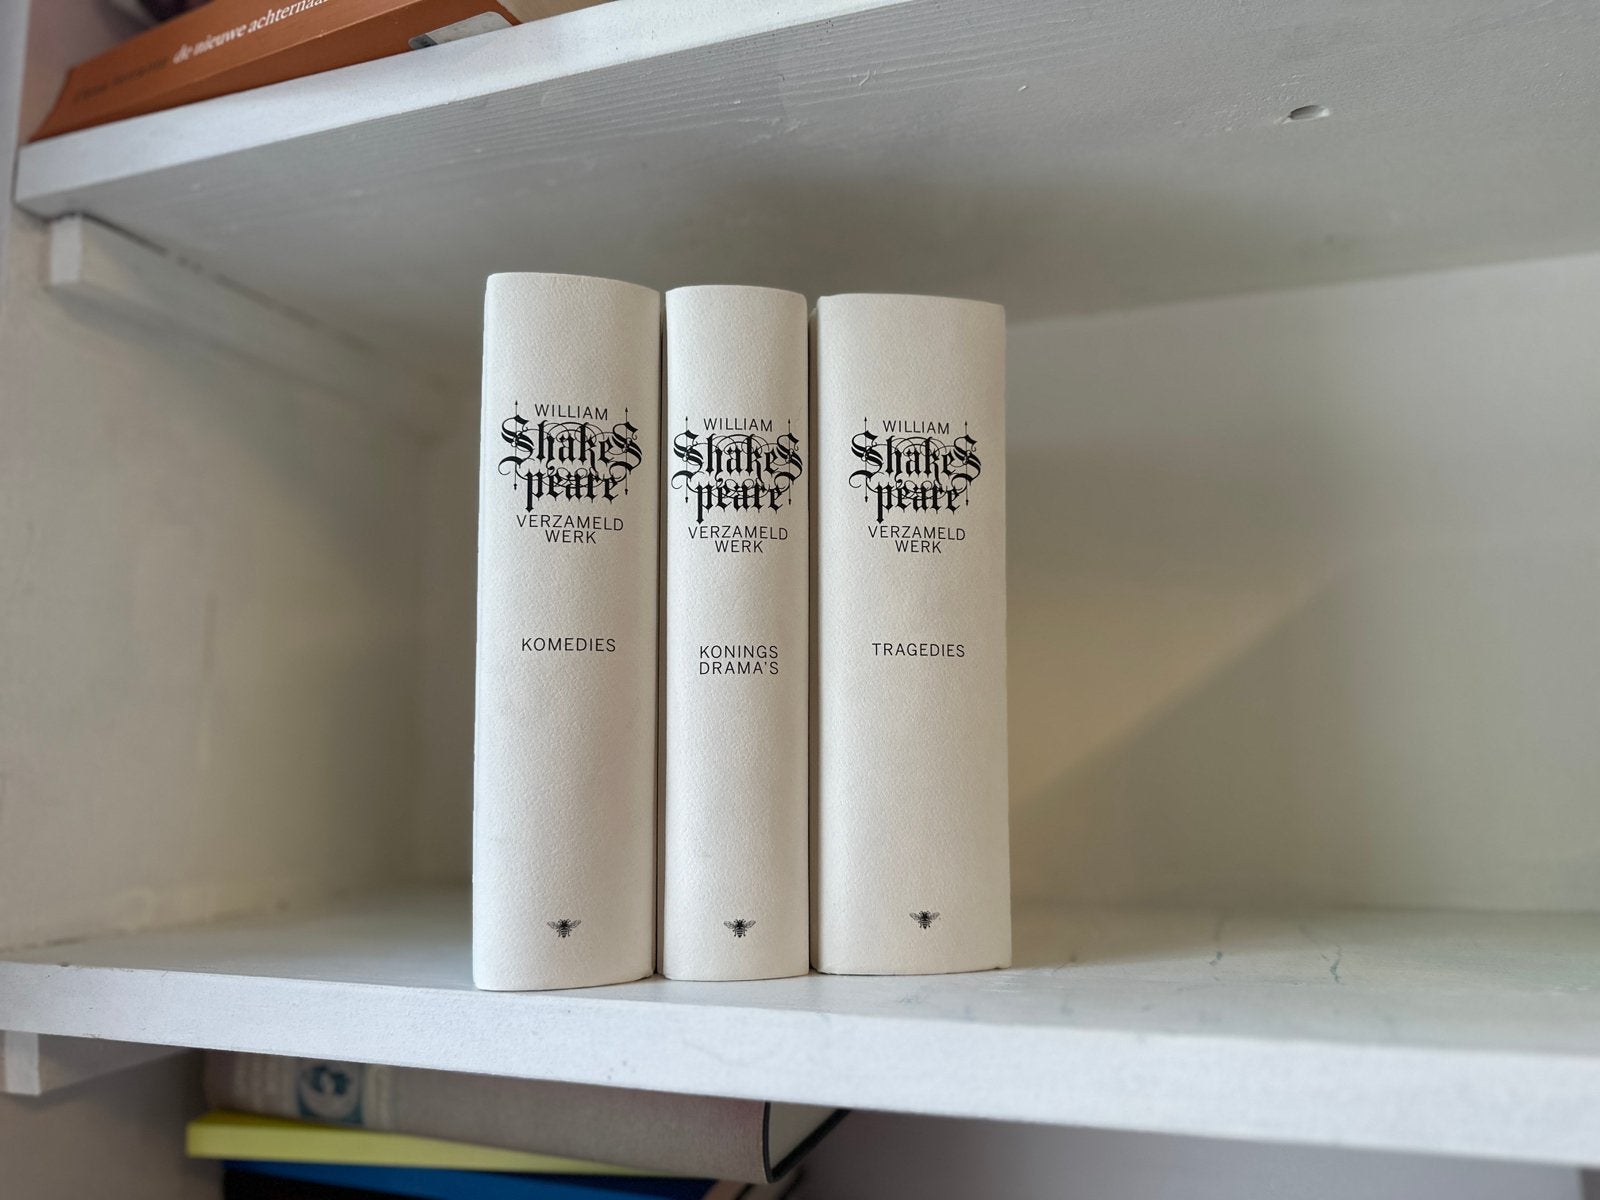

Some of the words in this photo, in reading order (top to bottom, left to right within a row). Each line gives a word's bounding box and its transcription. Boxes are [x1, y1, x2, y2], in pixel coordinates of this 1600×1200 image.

[172, 43, 194, 64] de
[193, 24, 247, 56] nieuwe
[534, 403, 608, 421] WILLIAM
[703, 417, 773, 432] WILLIAM
[882, 419, 950, 435] WILLIAM
[524, 468, 619, 513] peare
[695, 481, 783, 524] peare
[874, 482, 960, 524] peare
[516, 514, 624, 531] VERZAMELD
[545, 529, 597, 544] WERK
[688, 525, 788, 540] VERZAMELD
[868, 525, 966, 541] VERZAMELD
[714, 540, 764, 553] WERK
[895, 540, 942, 554] WERK
[521, 637, 616, 653] KOMEDIES
[699, 645, 779, 659] KONINGS
[871, 642, 966, 658] TRAGEDIES
[699, 661, 779, 675] DRAMA'S
